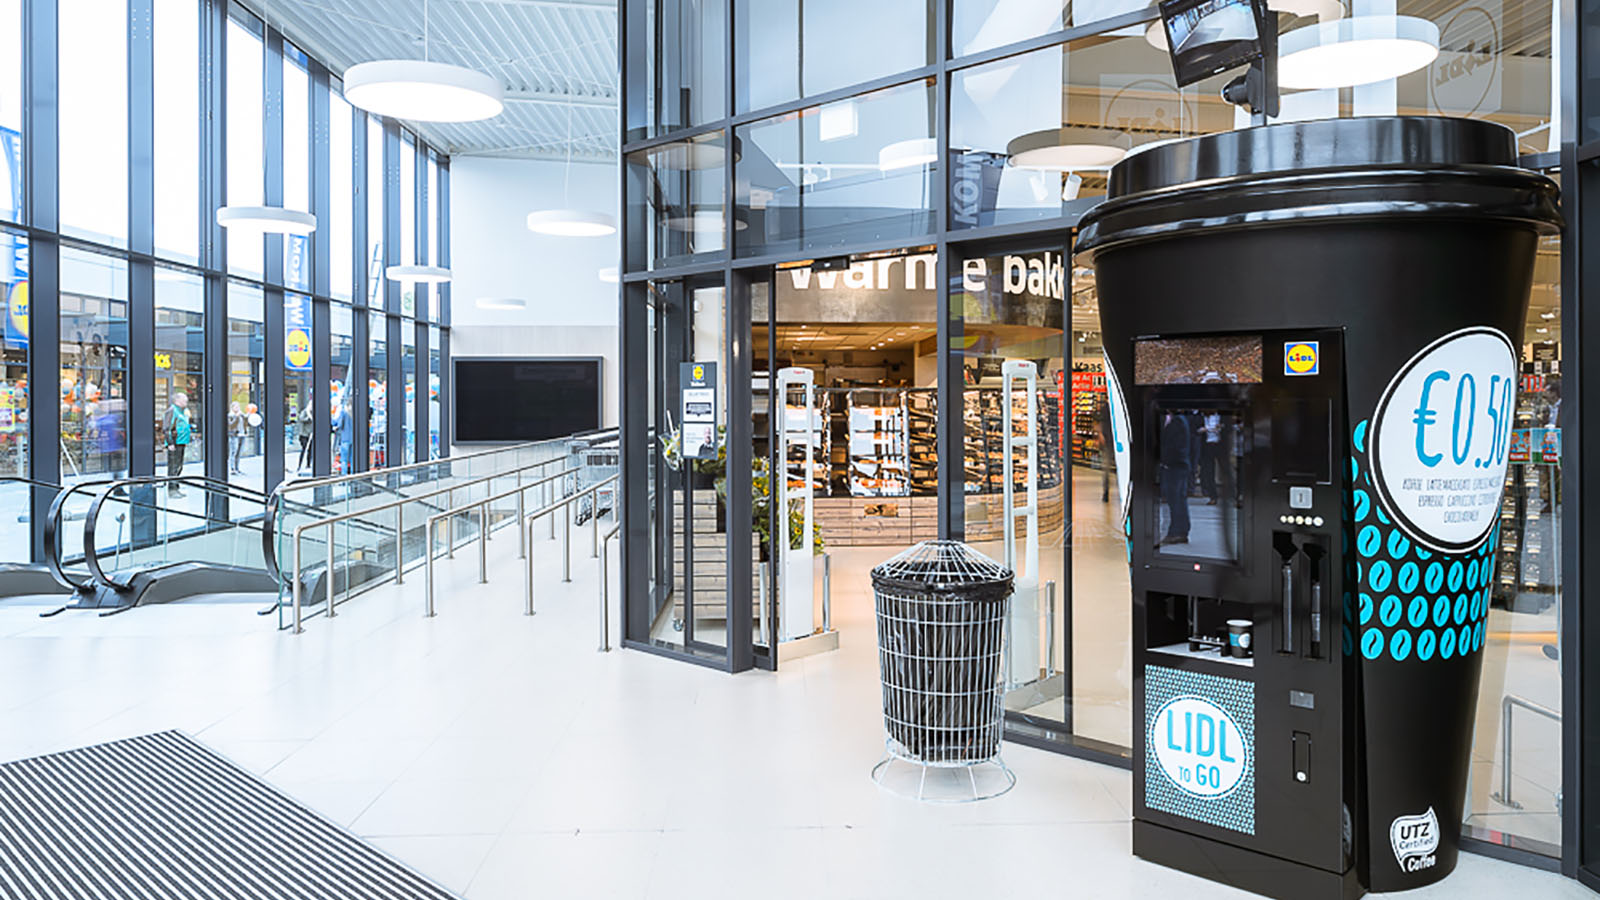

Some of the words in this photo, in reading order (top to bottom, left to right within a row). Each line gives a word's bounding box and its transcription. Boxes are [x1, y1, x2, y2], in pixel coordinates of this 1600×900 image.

[1413, 370, 1512, 468] €0.50
[1167, 709, 1236, 763] LIDL
[1178, 765, 1191, 783] TO
[1196, 763, 1220, 789] GO
[1400, 822, 1430, 840] UTZ
